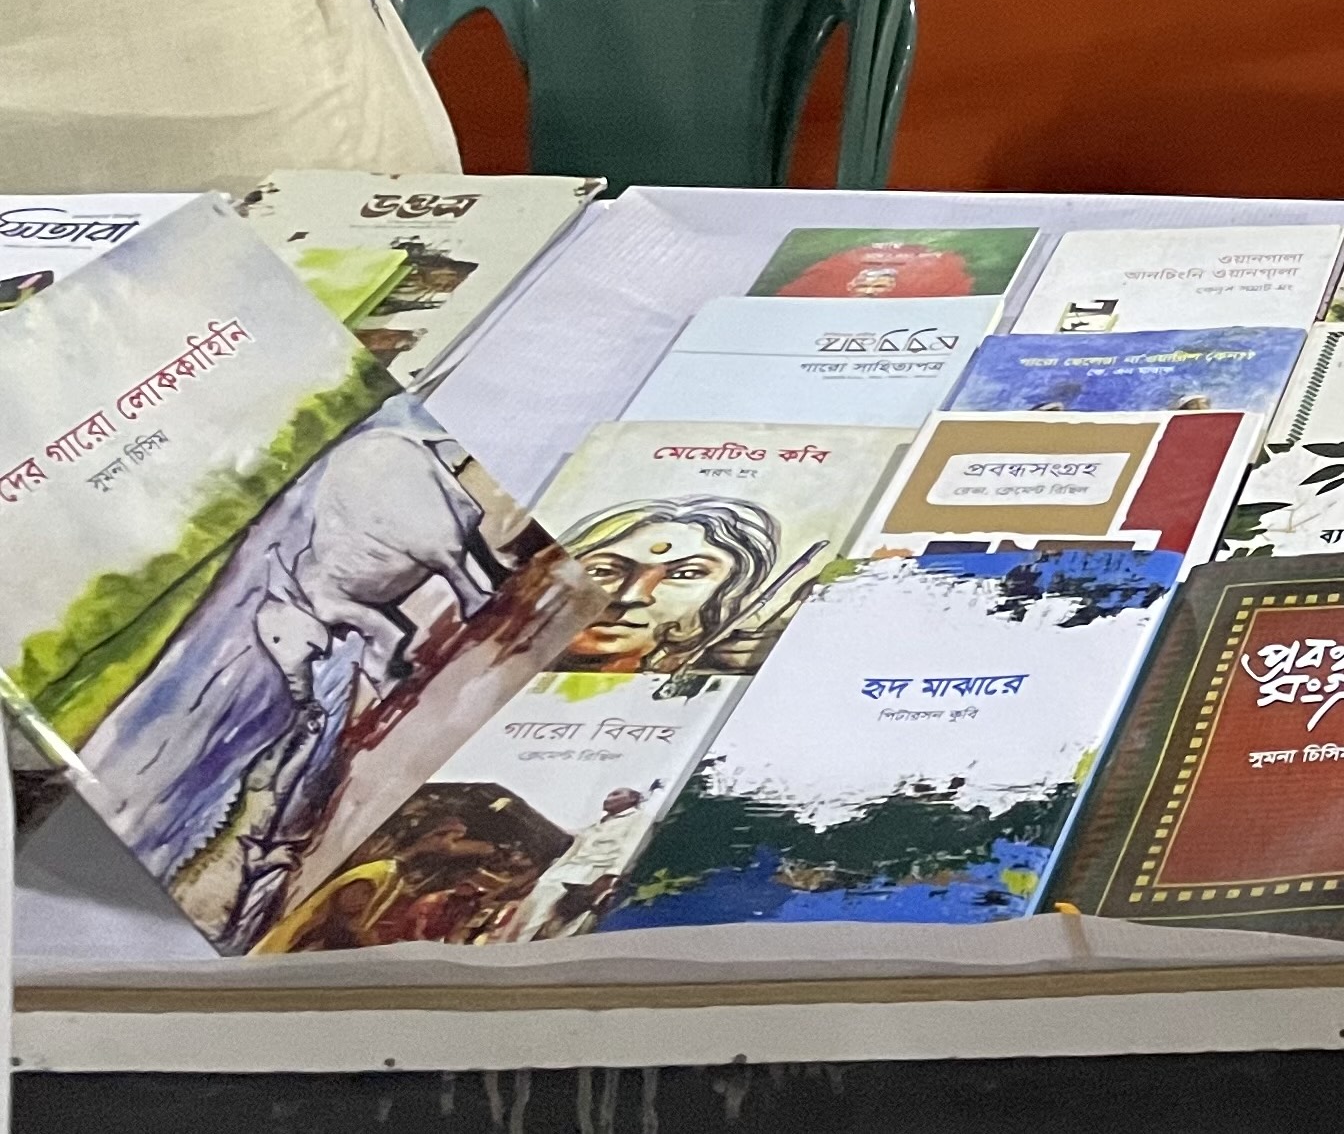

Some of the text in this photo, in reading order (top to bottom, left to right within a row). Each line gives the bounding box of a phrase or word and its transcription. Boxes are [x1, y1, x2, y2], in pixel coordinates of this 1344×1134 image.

[46, 410, 117, 464] গারো
[116, 320, 254, 420] লোককাহিনি
[653, 442, 832, 464] মেয়েটিও কবি
[963, 463, 1102, 477] প্রবন্ধসংগ্রহ
[921, 671, 1030, 699] মাঝারে
[505, 717, 683, 744] গারো বিবাহ
[1248, 749, 1299, 768] সুমনা
